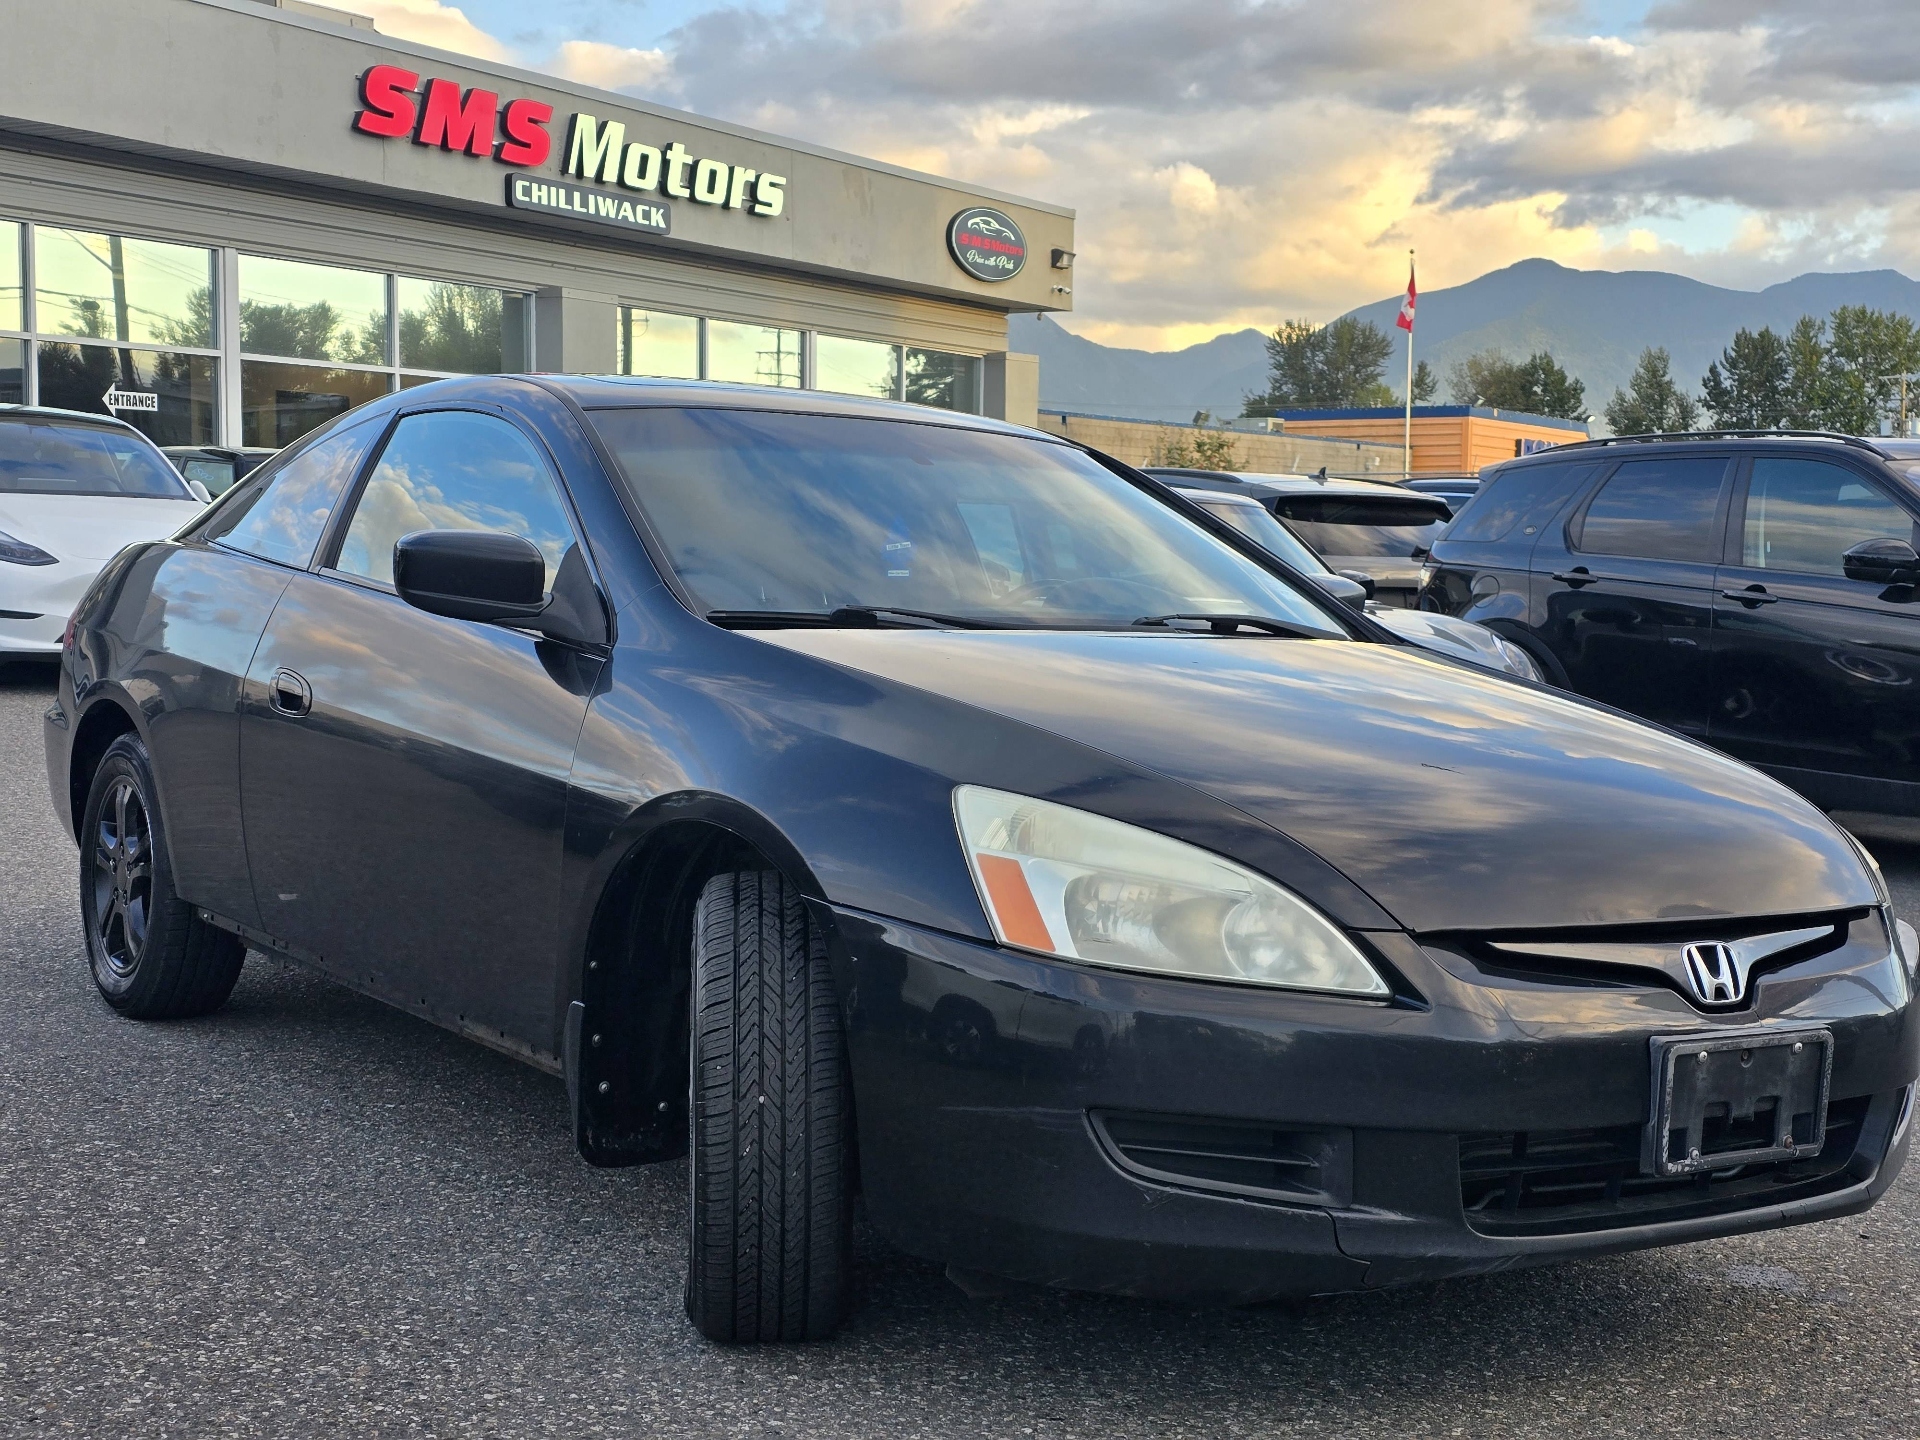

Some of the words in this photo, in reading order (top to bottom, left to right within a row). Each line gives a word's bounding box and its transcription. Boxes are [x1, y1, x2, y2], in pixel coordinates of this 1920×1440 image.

[356, 64, 554, 167] SMS
[566, 112, 787, 217] Motors
[515, 180, 667, 229] CHILLIWACK
[991, 240, 1024, 256] Motors
[108, 393, 156, 409] ENTRANCE
